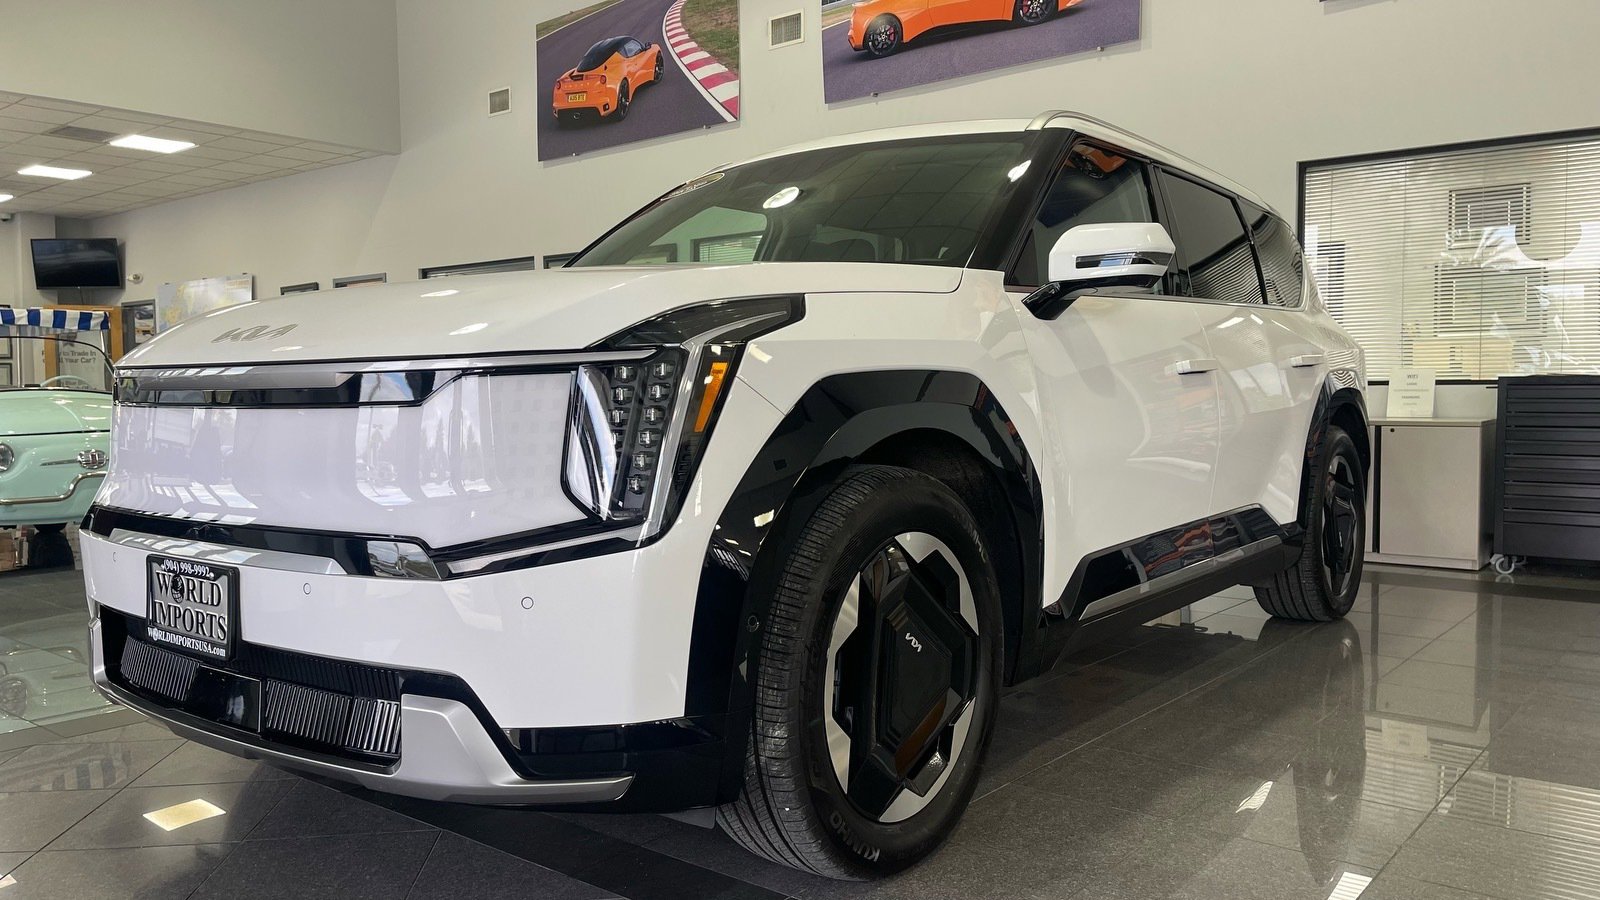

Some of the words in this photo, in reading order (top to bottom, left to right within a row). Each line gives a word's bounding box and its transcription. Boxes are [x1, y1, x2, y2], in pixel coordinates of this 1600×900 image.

[164, 559, 180, 574] (904)
[180, 562, 210, 577] 998-9992
[156, 570, 222, 606] WORLD
[154, 599, 227, 641] IMPORTS
[147, 626, 226, 657] WORLDIMPORTSUSA.com
